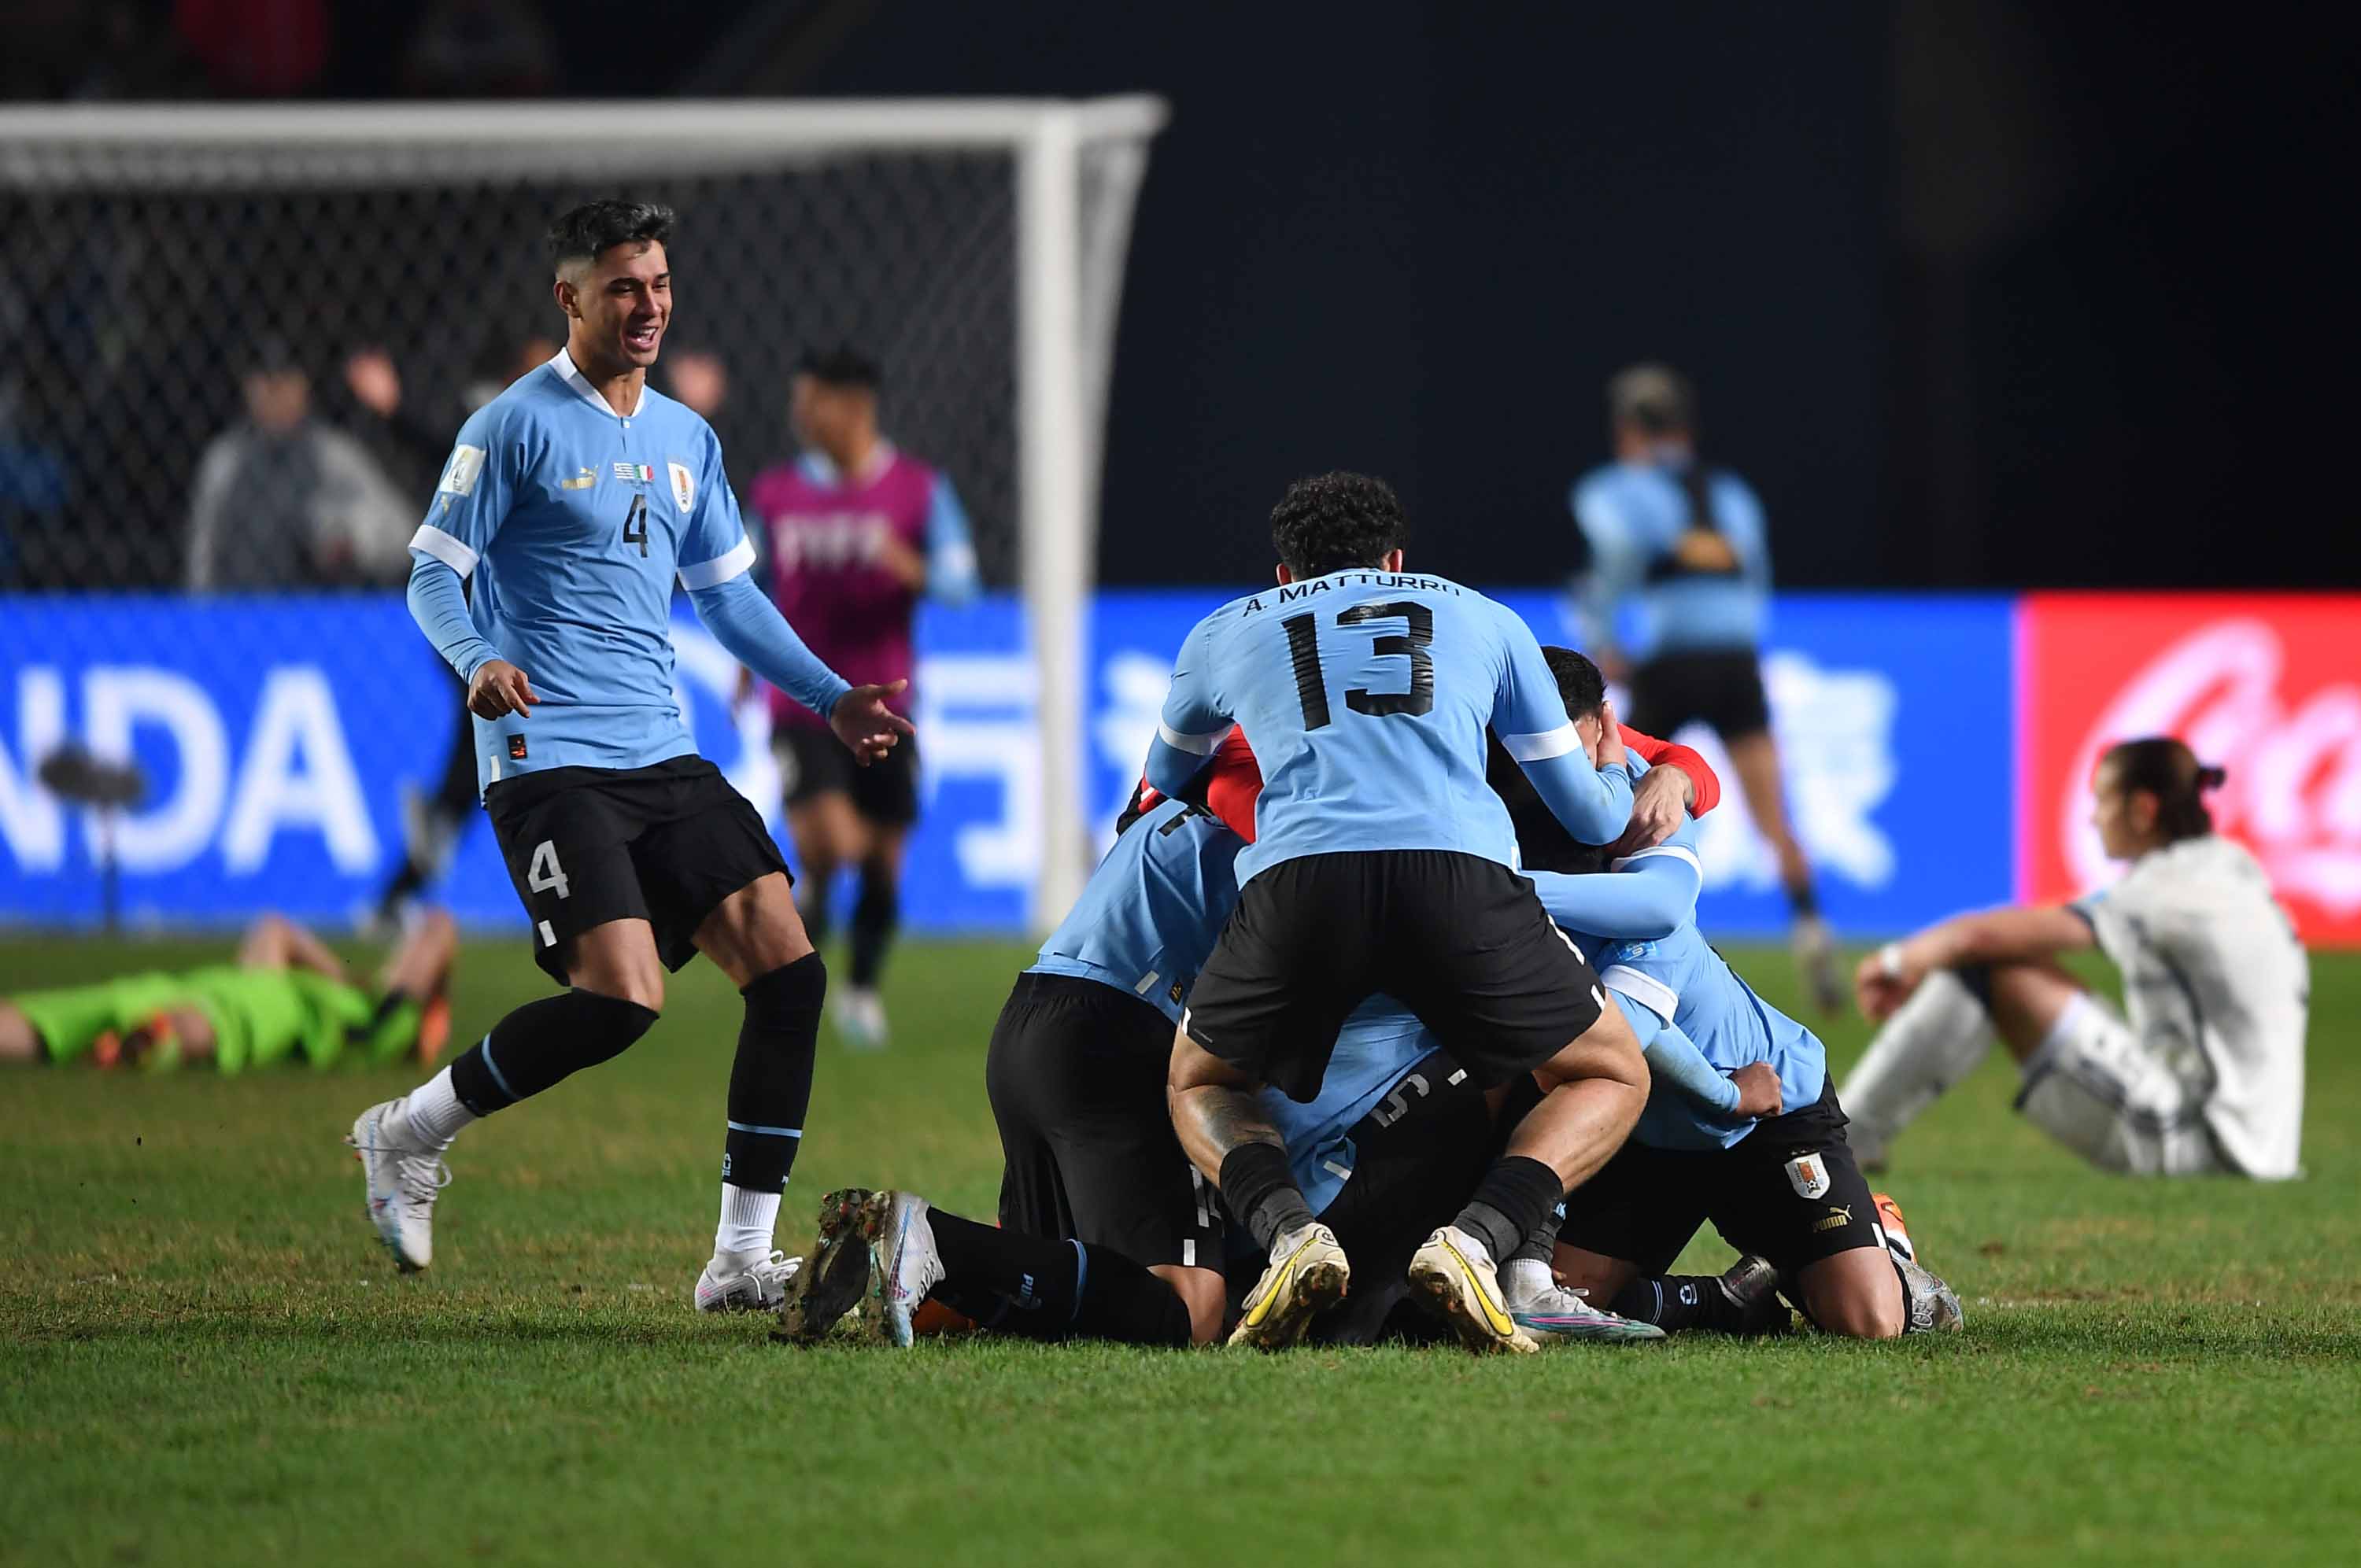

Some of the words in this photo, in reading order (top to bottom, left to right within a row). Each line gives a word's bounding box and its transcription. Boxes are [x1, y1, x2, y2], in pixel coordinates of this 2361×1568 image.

[623, 494, 648, 558] 4
[1243, 598, 1268, 617] A.
[1281, 601, 1434, 731] 13
[528, 839, 570, 899] 4
